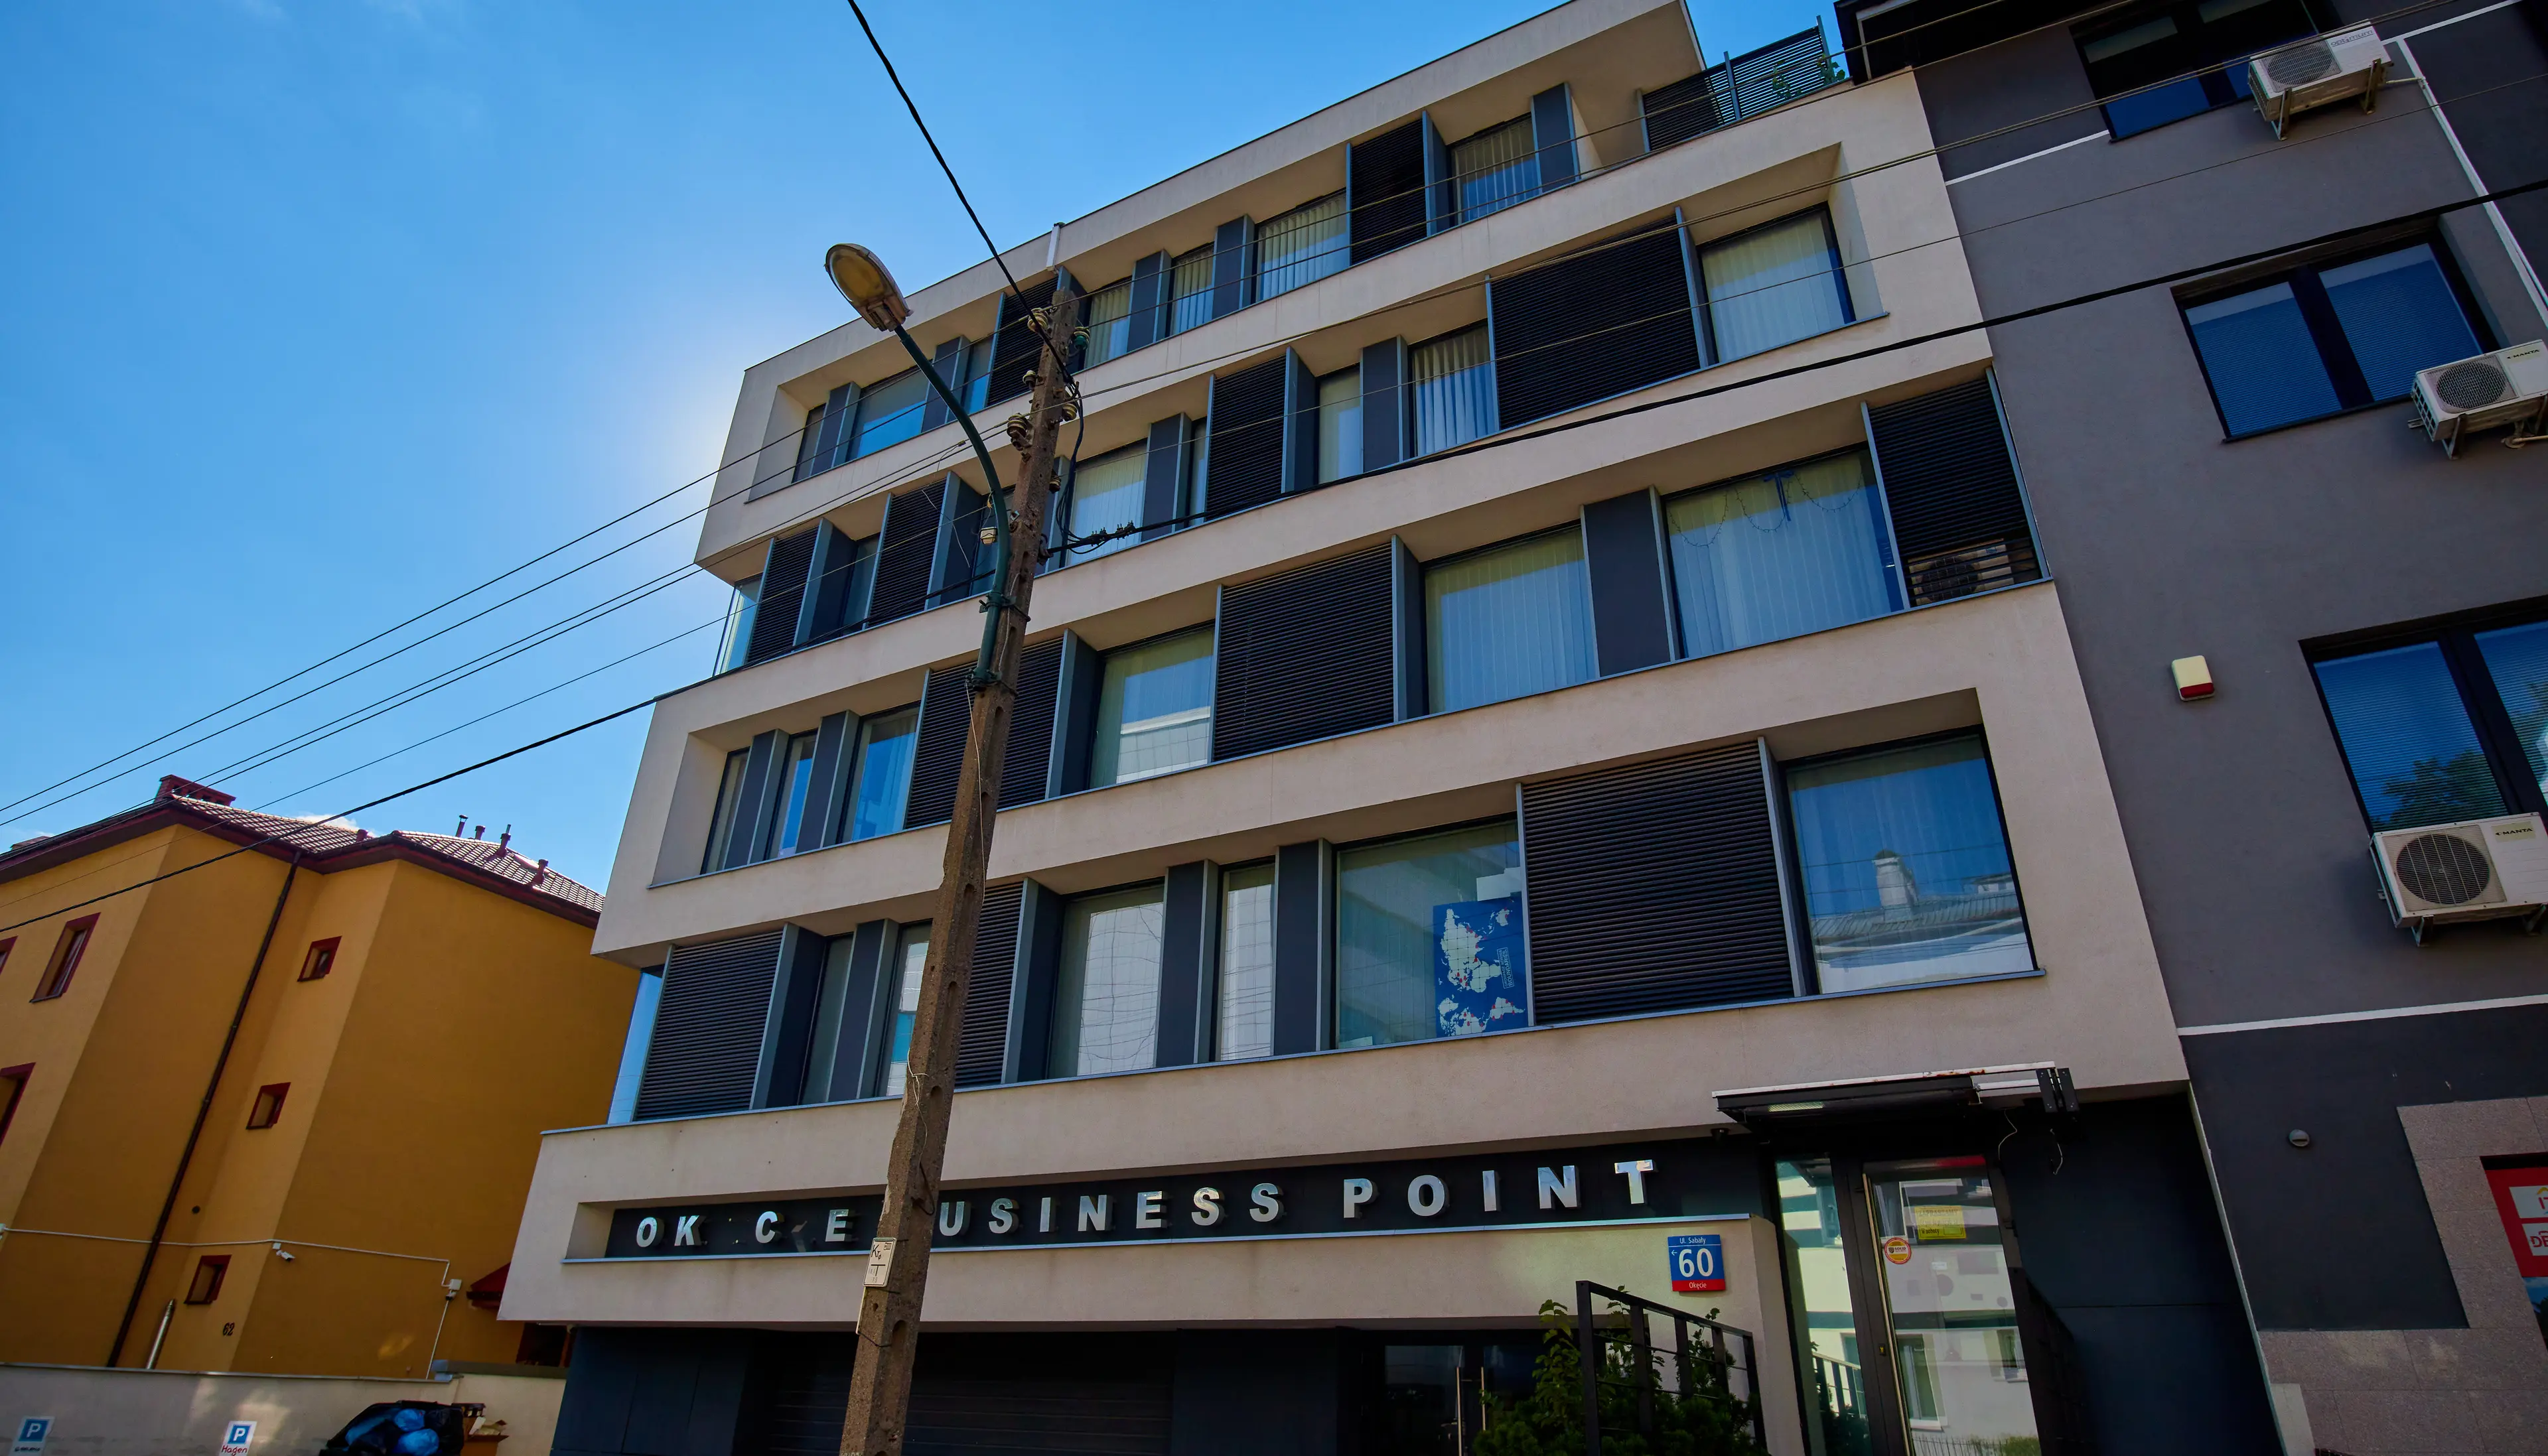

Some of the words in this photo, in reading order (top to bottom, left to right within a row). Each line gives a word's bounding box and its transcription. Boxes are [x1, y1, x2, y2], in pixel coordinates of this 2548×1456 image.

[939, 1182, 1286, 1237] USINESS
[1343, 1159, 1658, 1219] POINT
[1679, 1248, 1714, 1278] 60
[222, 1322, 235, 1336] 62
[27, 1423, 42, 1438] P
[233, 1427, 246, 1441] P
[221, 1445, 248, 1456] Hagen
